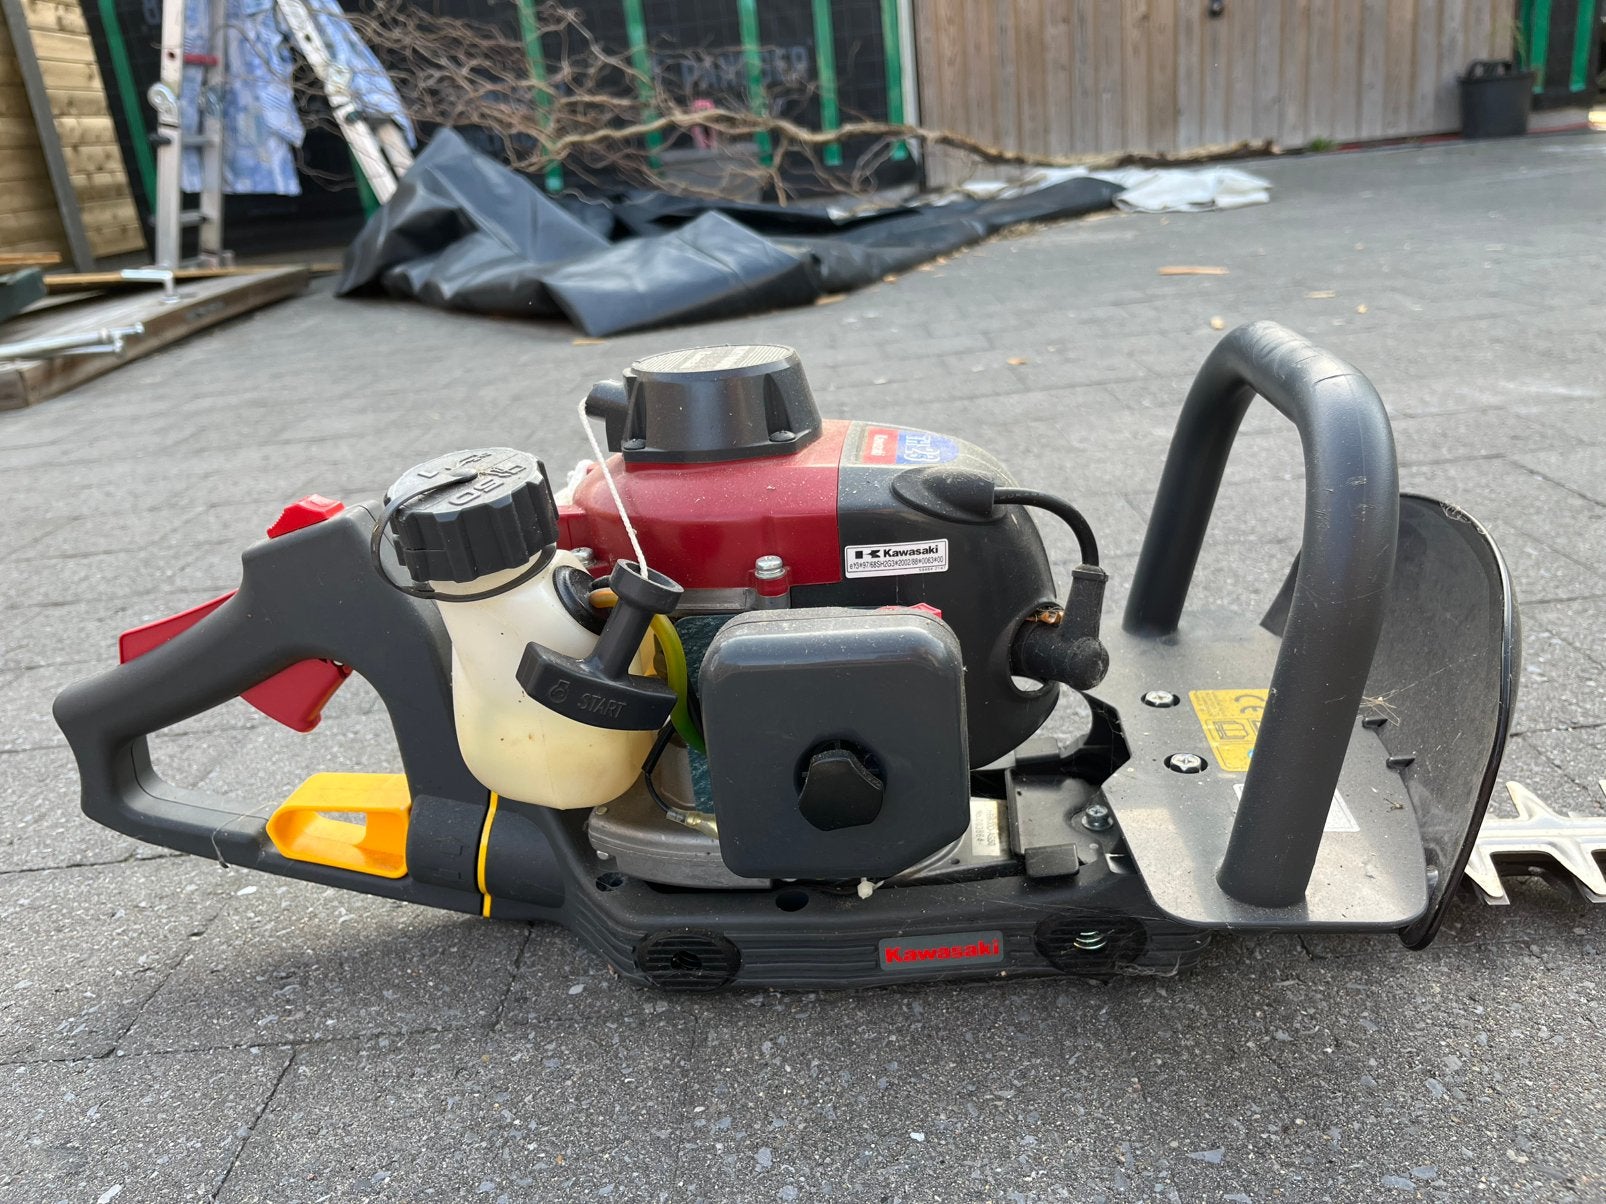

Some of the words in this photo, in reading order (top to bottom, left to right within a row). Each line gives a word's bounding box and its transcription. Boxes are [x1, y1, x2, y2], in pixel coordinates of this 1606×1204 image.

[883, 544, 939, 558] Kawasaki
[577, 692, 627, 719] START
[885, 938, 1000, 964] Kawasaki
